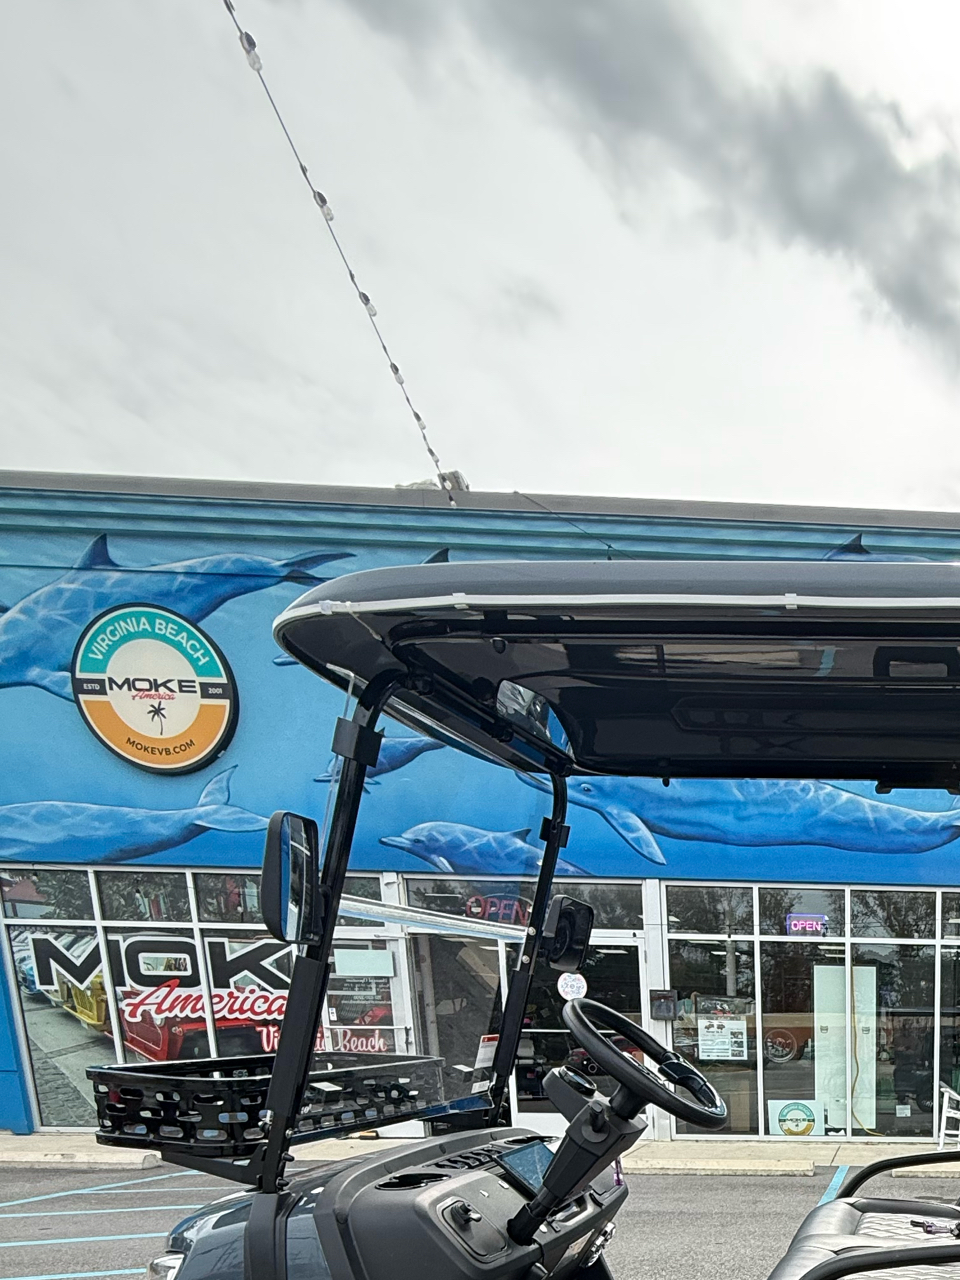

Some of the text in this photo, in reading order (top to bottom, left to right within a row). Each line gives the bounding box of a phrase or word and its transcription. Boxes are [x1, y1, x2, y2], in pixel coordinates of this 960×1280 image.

[88, 616, 210, 666] VIRGINIA BEACH
[83, 683, 100, 691] ESTD
[107, 676, 198, 694] MOKE
[131, 689, 176, 701] America
[125, 737, 196, 756] MOKEVB.COM
[465, 895, 530, 927] OPEN
[791, 920, 822, 931] OPEN
[31, 936, 376, 995] MOK
[120, 977, 289, 1023] America
[334, 1028, 387, 1052] Beach
